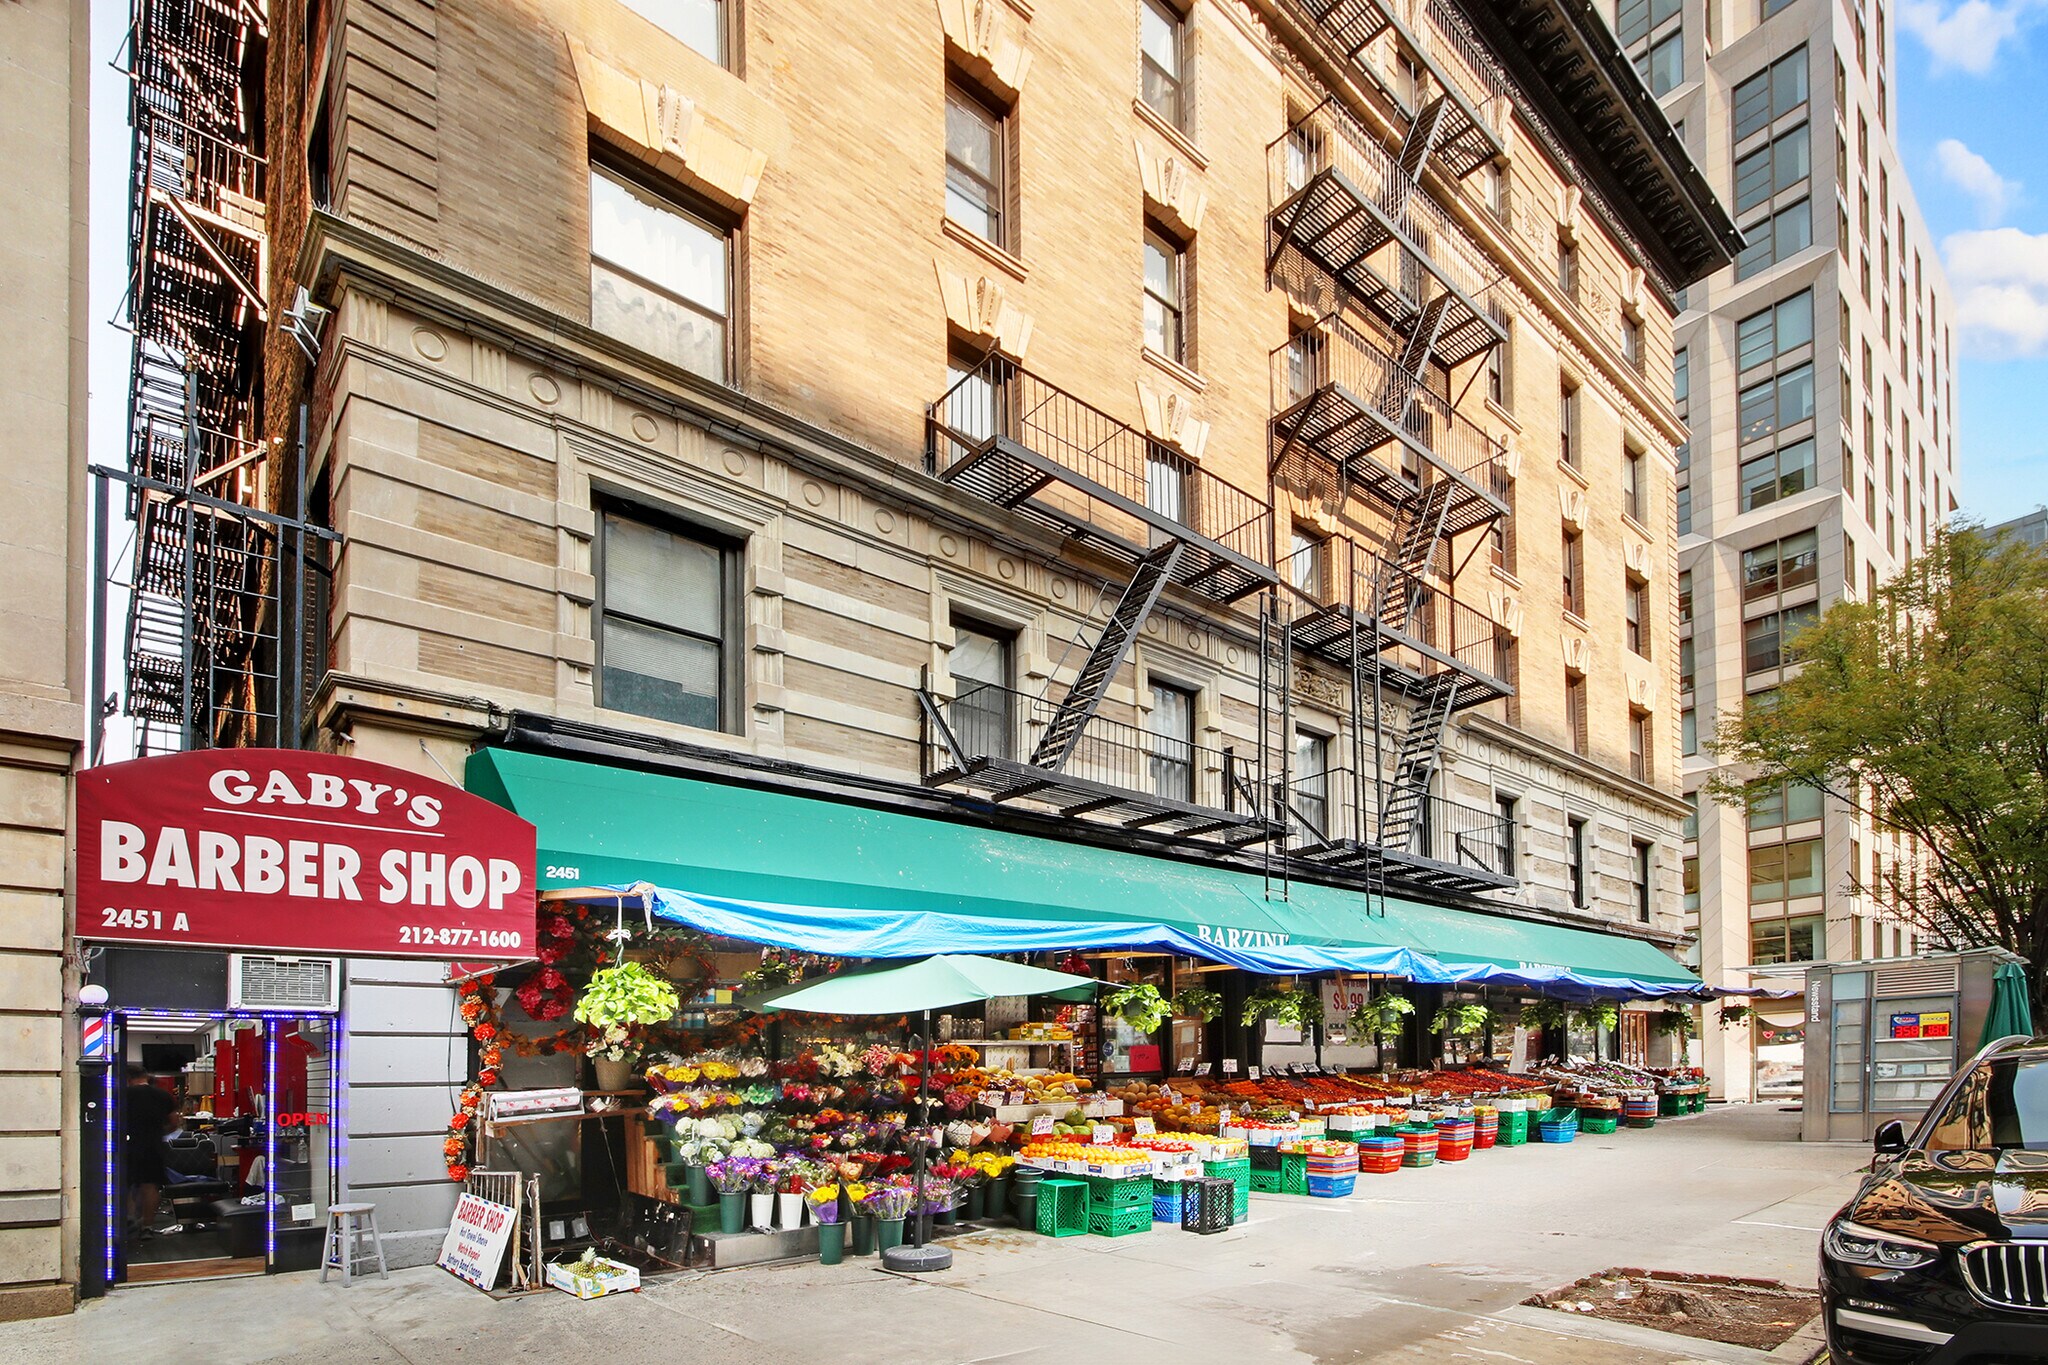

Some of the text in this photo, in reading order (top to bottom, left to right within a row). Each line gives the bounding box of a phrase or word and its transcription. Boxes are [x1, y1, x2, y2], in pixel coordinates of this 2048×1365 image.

[208, 769, 443, 828] GABY'S
[100, 819, 521, 910] BARBER SHOP
[546, 865, 580, 880] 2451
[101, 907, 190, 932] 2451 A
[399, 926, 521, 949] 212-877-1600
[1811, 980, 1821, 1022] Newsstand
[1895, 1026, 1919, 1037] 358
[276, 1112, 328, 1127] OPEN
[458, 1200, 505, 1234] BARBER SHOP
[466, 1229, 477, 1242] Towel
[467, 1247, 481, 1261] Repair
[459, 1259, 470, 1272] Band
